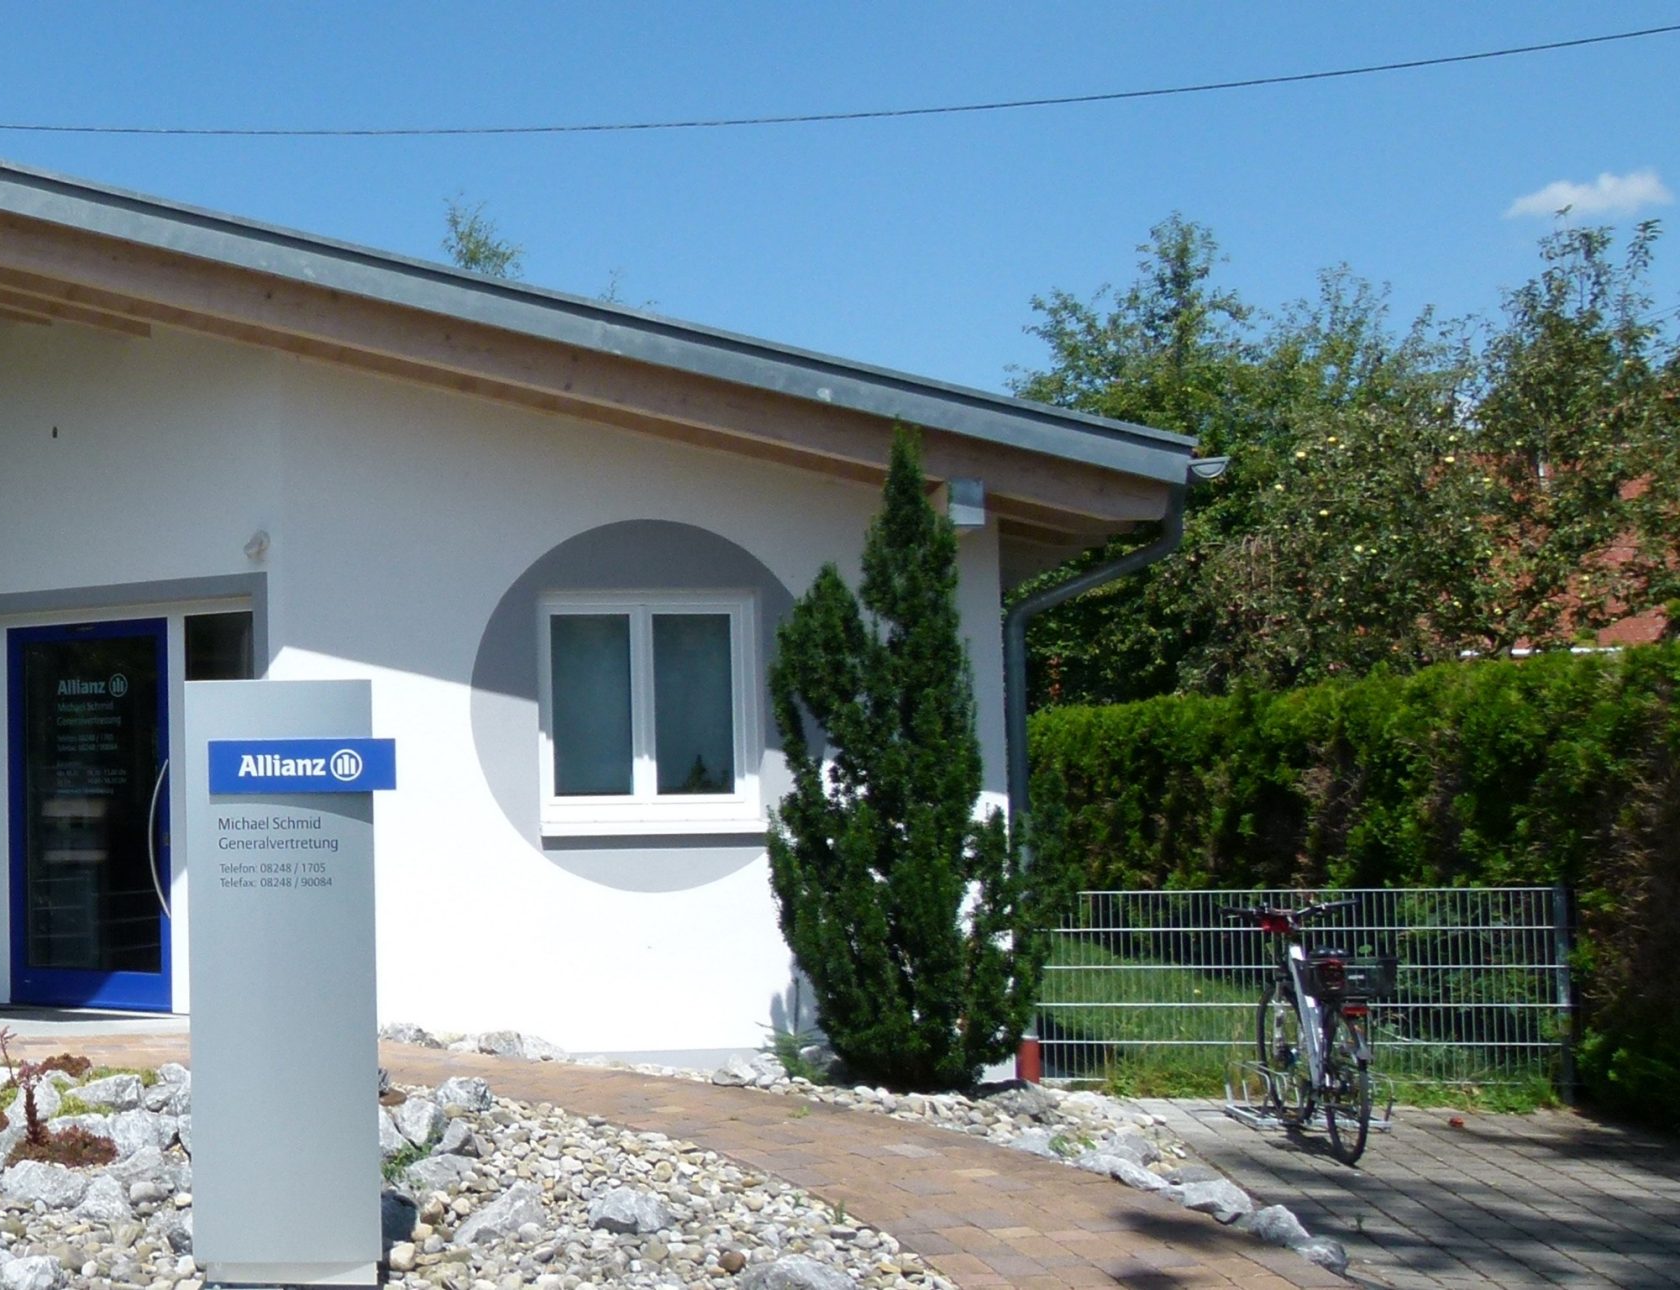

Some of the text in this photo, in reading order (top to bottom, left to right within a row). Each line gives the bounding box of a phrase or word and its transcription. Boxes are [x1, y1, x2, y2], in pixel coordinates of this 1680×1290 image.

[57, 677, 106, 695] Allianz
[238, 754, 326, 777] Allianz
[218, 816, 321, 831] Michael Schmid
[218, 837, 339, 853] Generalvertretung
[219, 863, 256, 874] Telefon:
[260, 863, 292, 873] 08248
[302, 863, 326, 873] 1705
[220, 877, 256, 888] Telefax:
[260, 877, 292, 887] 08248
[301, 876, 333, 887] 90084
